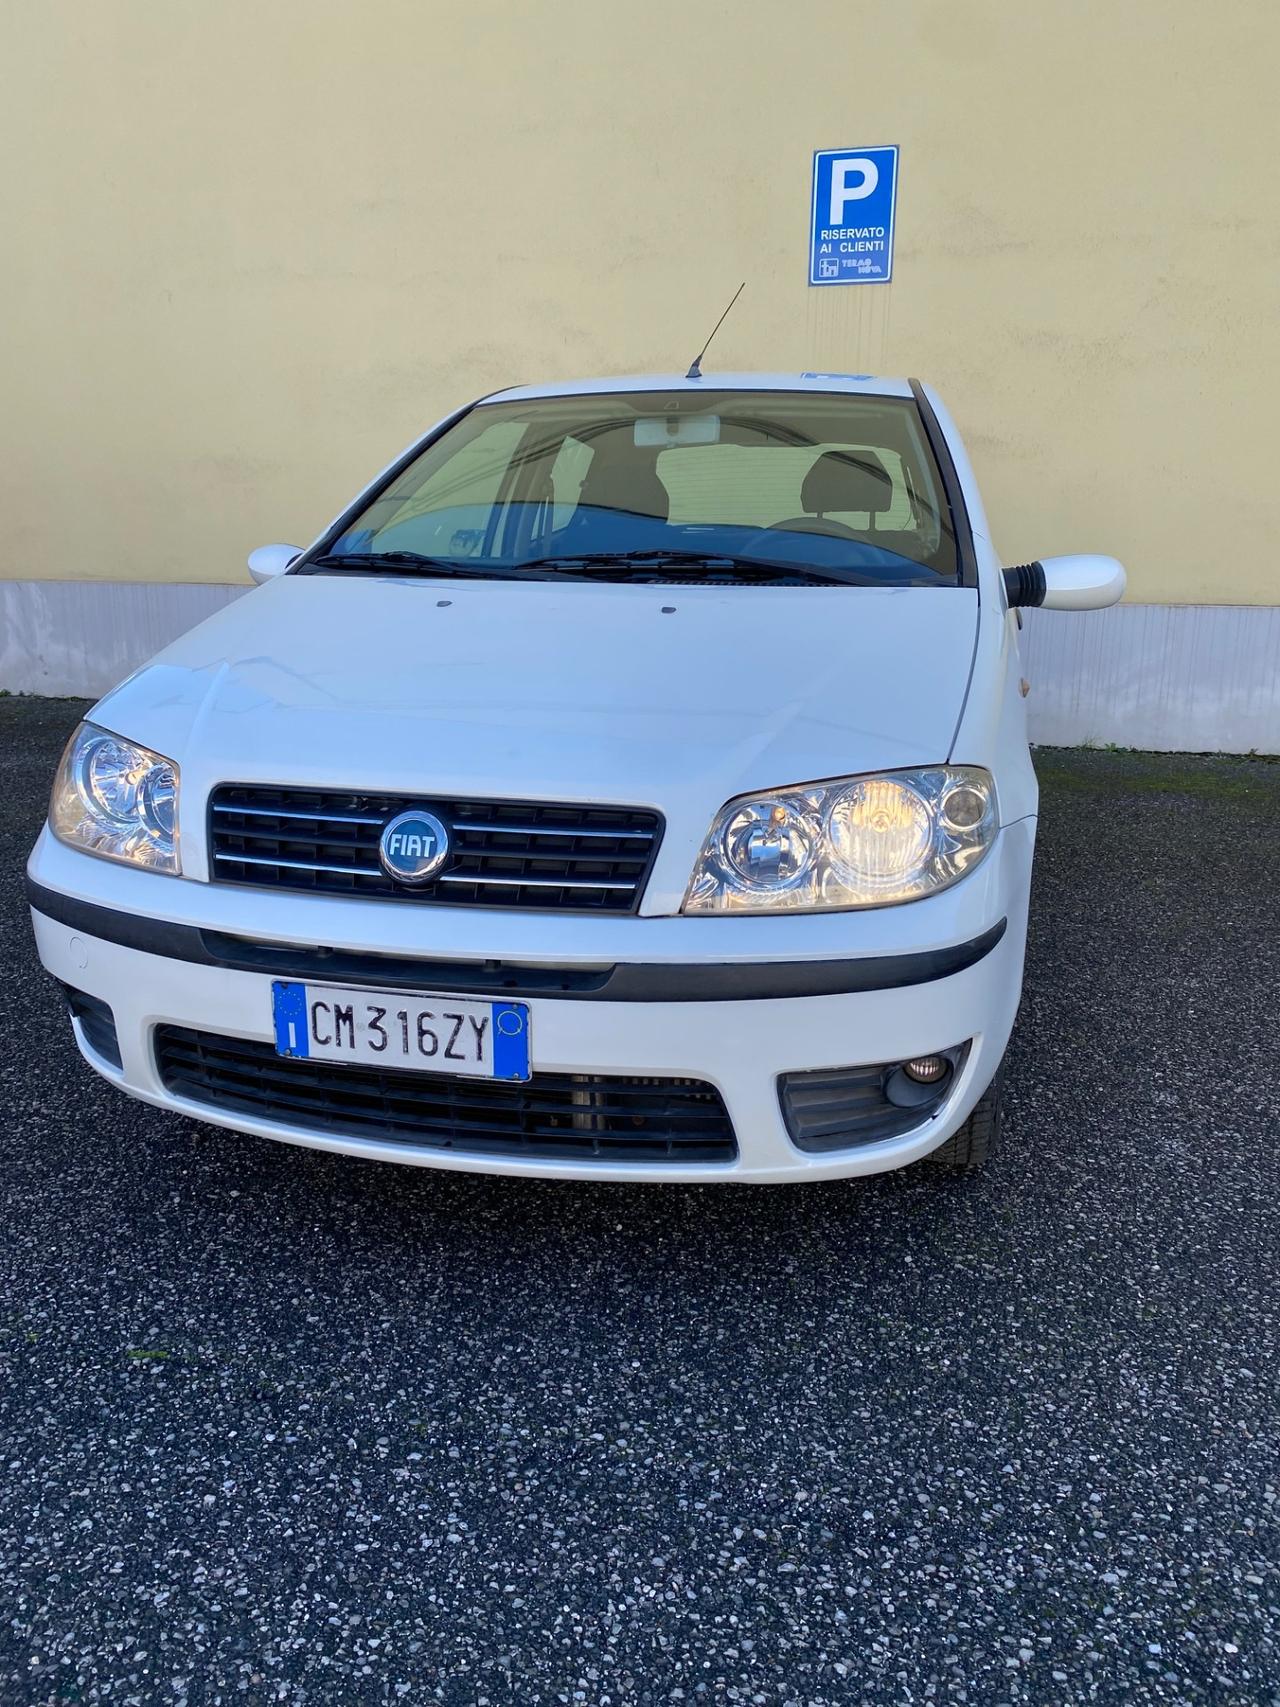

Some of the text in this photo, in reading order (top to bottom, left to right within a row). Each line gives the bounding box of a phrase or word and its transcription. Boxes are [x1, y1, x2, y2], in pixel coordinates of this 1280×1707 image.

[829, 158, 879, 225] P
[821, 227, 885, 240] RISERVATO
[820, 240, 884, 254] AI CLIENTI
[389, 833, 435, 858] FIAT
[288, 1022, 297, 1048] I
